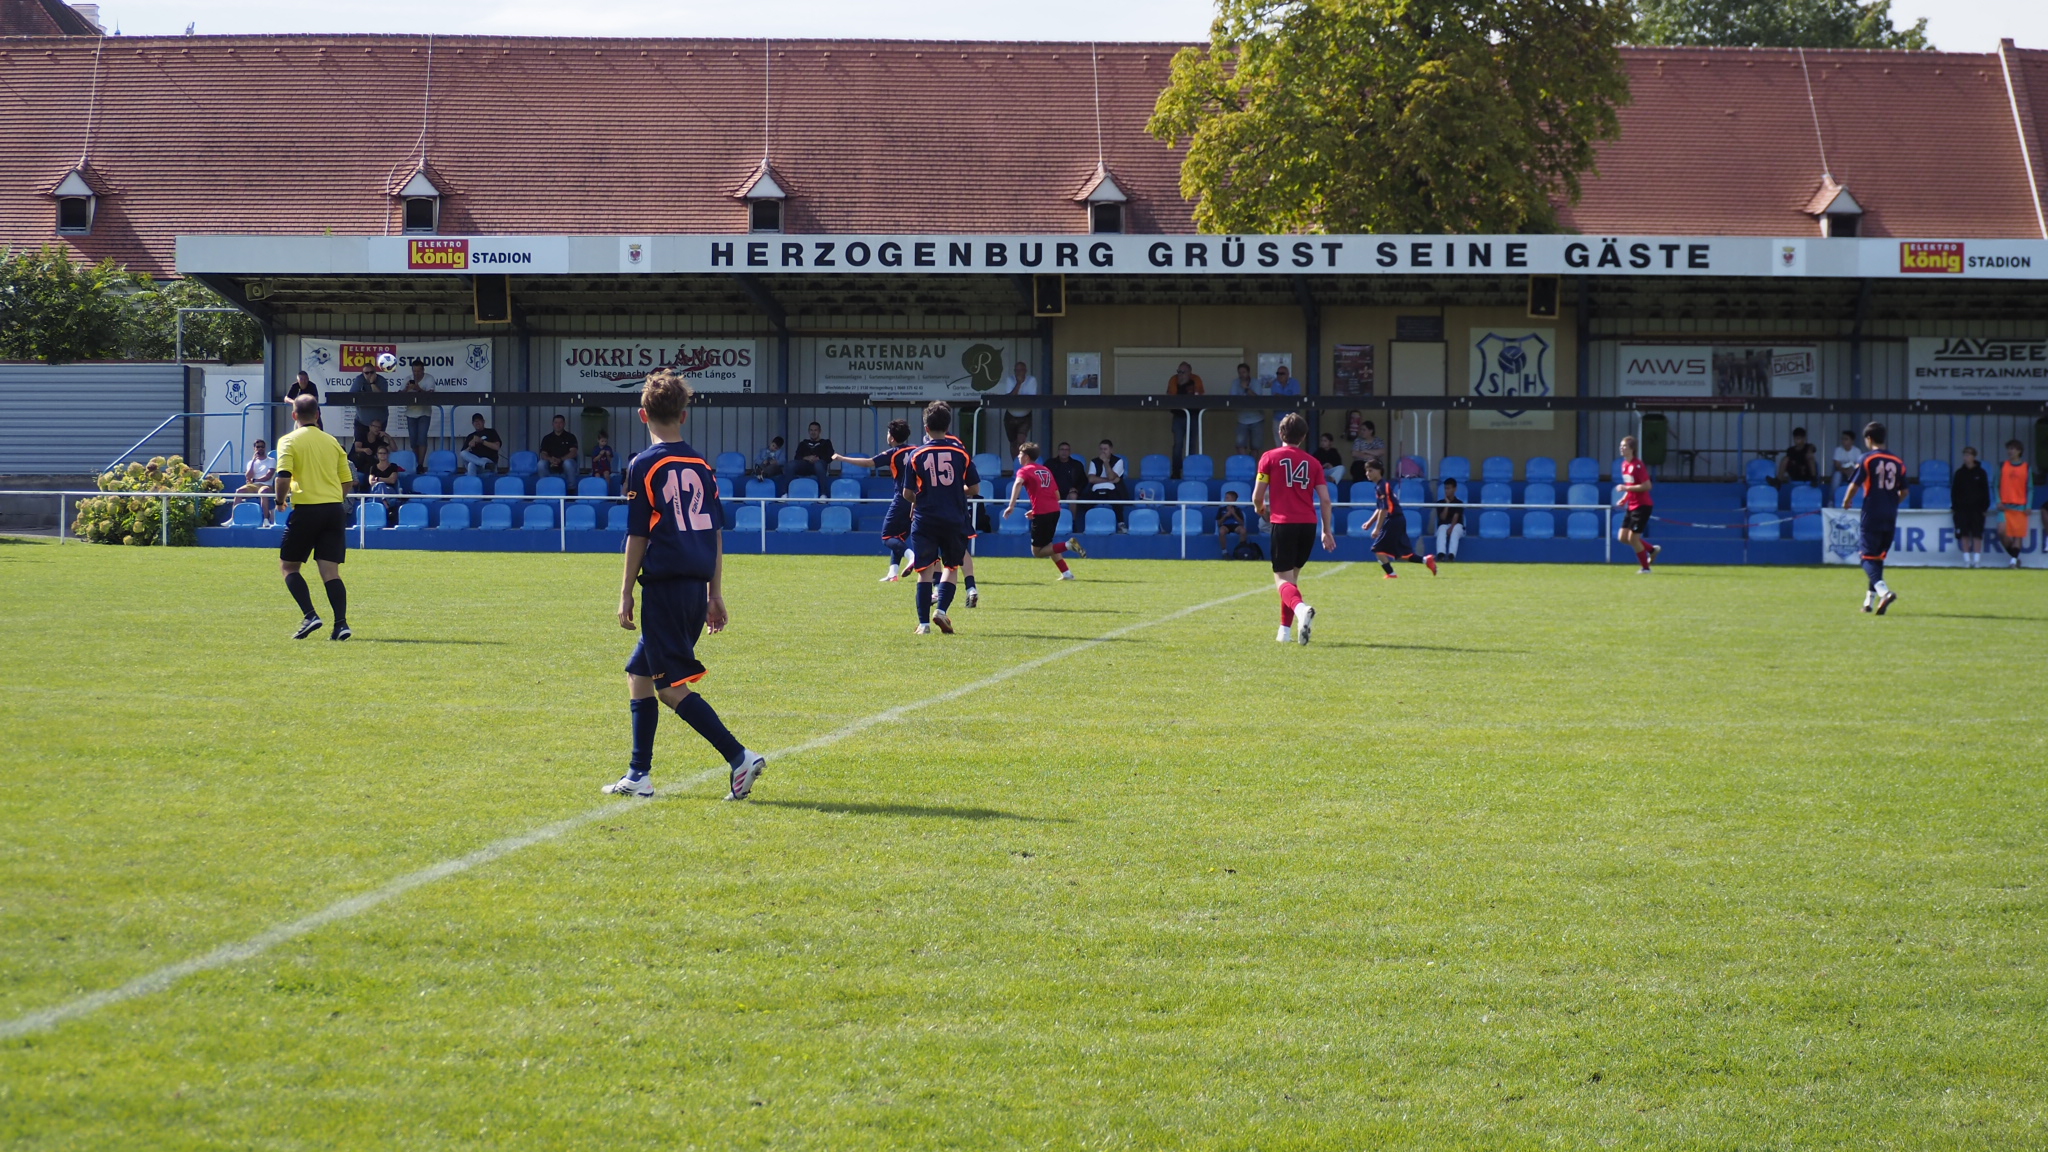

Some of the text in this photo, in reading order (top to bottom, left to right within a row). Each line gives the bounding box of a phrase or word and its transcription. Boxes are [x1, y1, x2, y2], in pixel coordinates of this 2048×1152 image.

[412, 241, 532, 269] könig STADION
[710, 237, 1711, 269] HERZOGENBURG GRÜSST SEINE GÄSTE
[1903, 244, 2030, 272] könig STADION
[658, 343, 752, 367] LÁNGOS
[825, 344, 946, 359] GARTENBAU
[705, 369, 736, 380] Lángos
[848, 361, 924, 371] HAUSMANN
[969, 351, 998, 382] R
[1627, 358, 1706, 374] MWS
[923, 452, 955, 487] 15
[1279, 458, 1310, 489] 14
[1875, 460, 1897, 491] 13
[662, 468, 713, 531] 12
